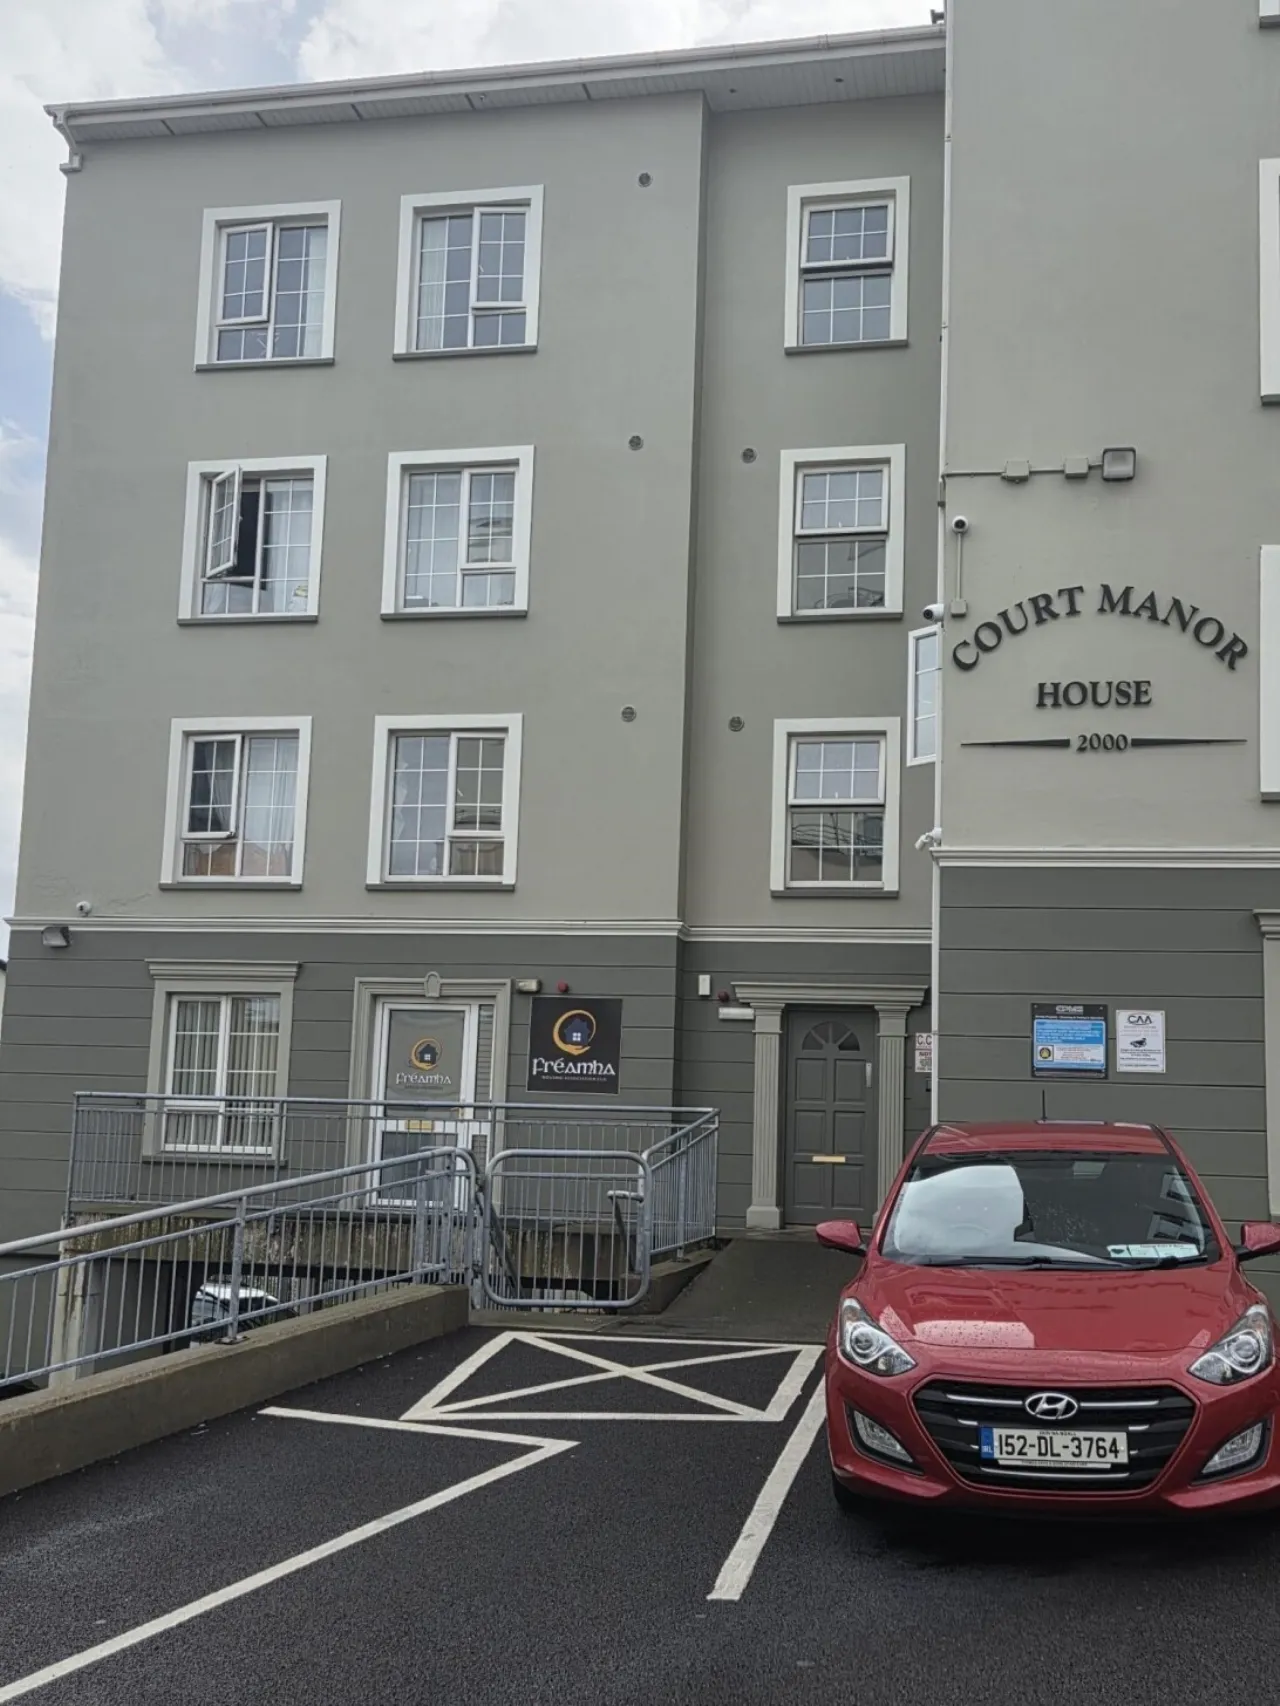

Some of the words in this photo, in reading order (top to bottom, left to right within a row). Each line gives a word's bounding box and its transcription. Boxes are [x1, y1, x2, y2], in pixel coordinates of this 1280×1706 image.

[952, 586, 1085, 672] COURT
[1097, 584, 1249, 671] MANOR
[1036, 680, 1152, 708] HOUSE
[1076, 733, 1128, 752] 2000
[998, 1434, 1120, 1459] 152-DL-3764
